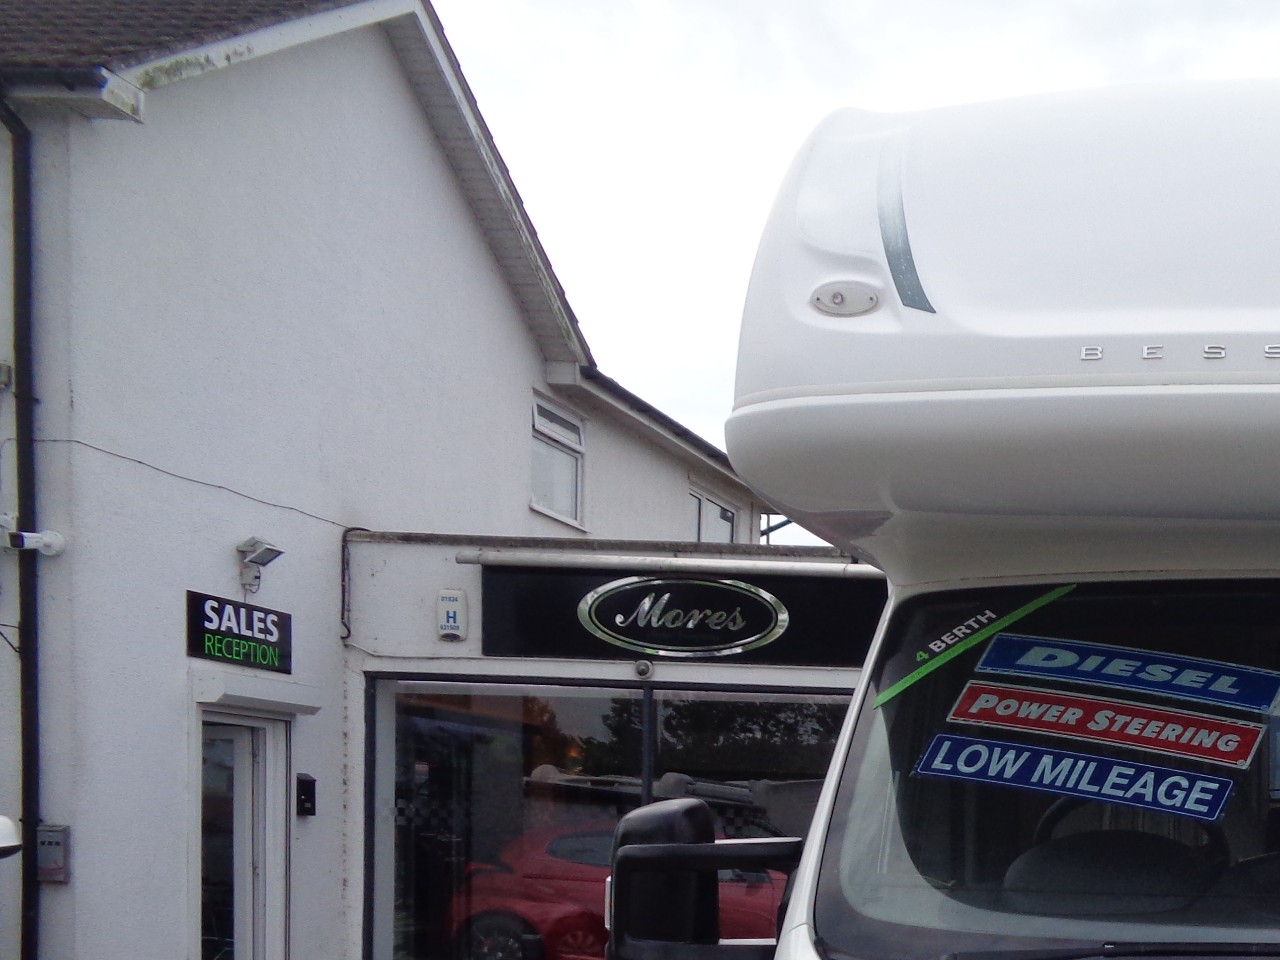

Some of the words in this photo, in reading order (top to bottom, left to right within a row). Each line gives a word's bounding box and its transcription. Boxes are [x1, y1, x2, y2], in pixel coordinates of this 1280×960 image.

[204, 599, 279, 642] SALES
[446, 610, 457, 624] H
[614, 592, 746, 631] Mores
[205, 633, 278, 667] RECEPTION
[915, 650, 930, 662] 4
[928, 609, 997, 653] BERTH
[1016, 647, 1240, 694] DIESEL
[968, 694, 1083, 726] POWER
[1086, 709, 1242, 753] STEERING
[932, 741, 1029, 779] LOW
[1030, 755, 1220, 813] MILEAGE
